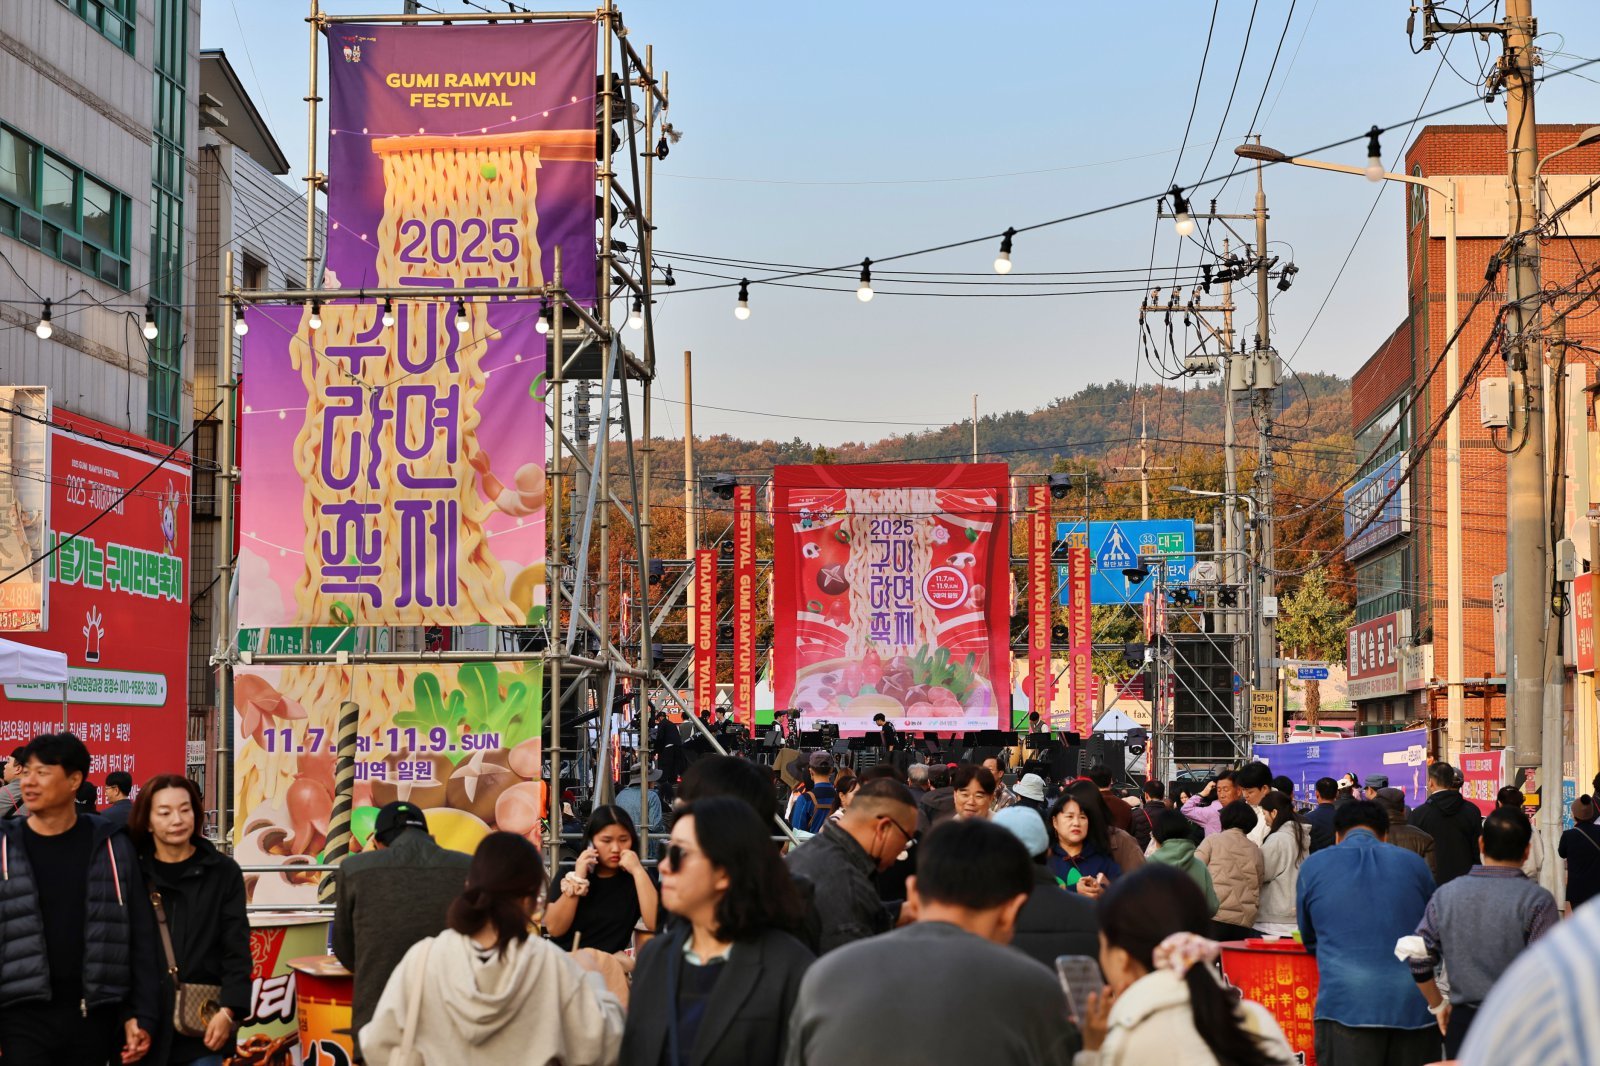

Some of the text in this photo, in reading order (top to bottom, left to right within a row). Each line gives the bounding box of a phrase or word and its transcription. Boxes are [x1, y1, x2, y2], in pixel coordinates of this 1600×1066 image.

[386, 71, 537, 88] GUMI RAMYUN
[410, 92, 513, 108] FESTIVAL
[399, 218, 521, 264] 2025
[321, 383, 458, 490] 라면
[740, 502, 752, 570] FESTIVAL
[870, 520, 914, 536] 2025
[1067, 536, 1087, 548] 514
[1142, 535, 1153, 543] 33
[1158, 535, 1183, 548] 대구
[320, 499, 458, 609] 축제
[870, 540, 914, 573] 구미
[1140, 545, 1155, 554] 514
[60, 532, 103, 590] 즐기는
[106, 541, 182, 604] 구미라면축제
[700, 552, 712, 613] RAMYUN
[1034, 551, 1046, 612] RAMYUN
[1151, 565, 1186, 577] 산단지
[740, 574, 752, 613] GUMI
[870, 576, 914, 609] 라면
[870, 612, 914, 645] 축제
[1034, 613, 1046, 650] GUMI
[1073, 580, 1086, 648] FESTIVAL
[700, 614, 712, 651] GUMI
[740, 613, 752, 674] RAMYUN
[1074, 654, 1087, 690] GUMI
[397, 761, 432, 781] 일원
